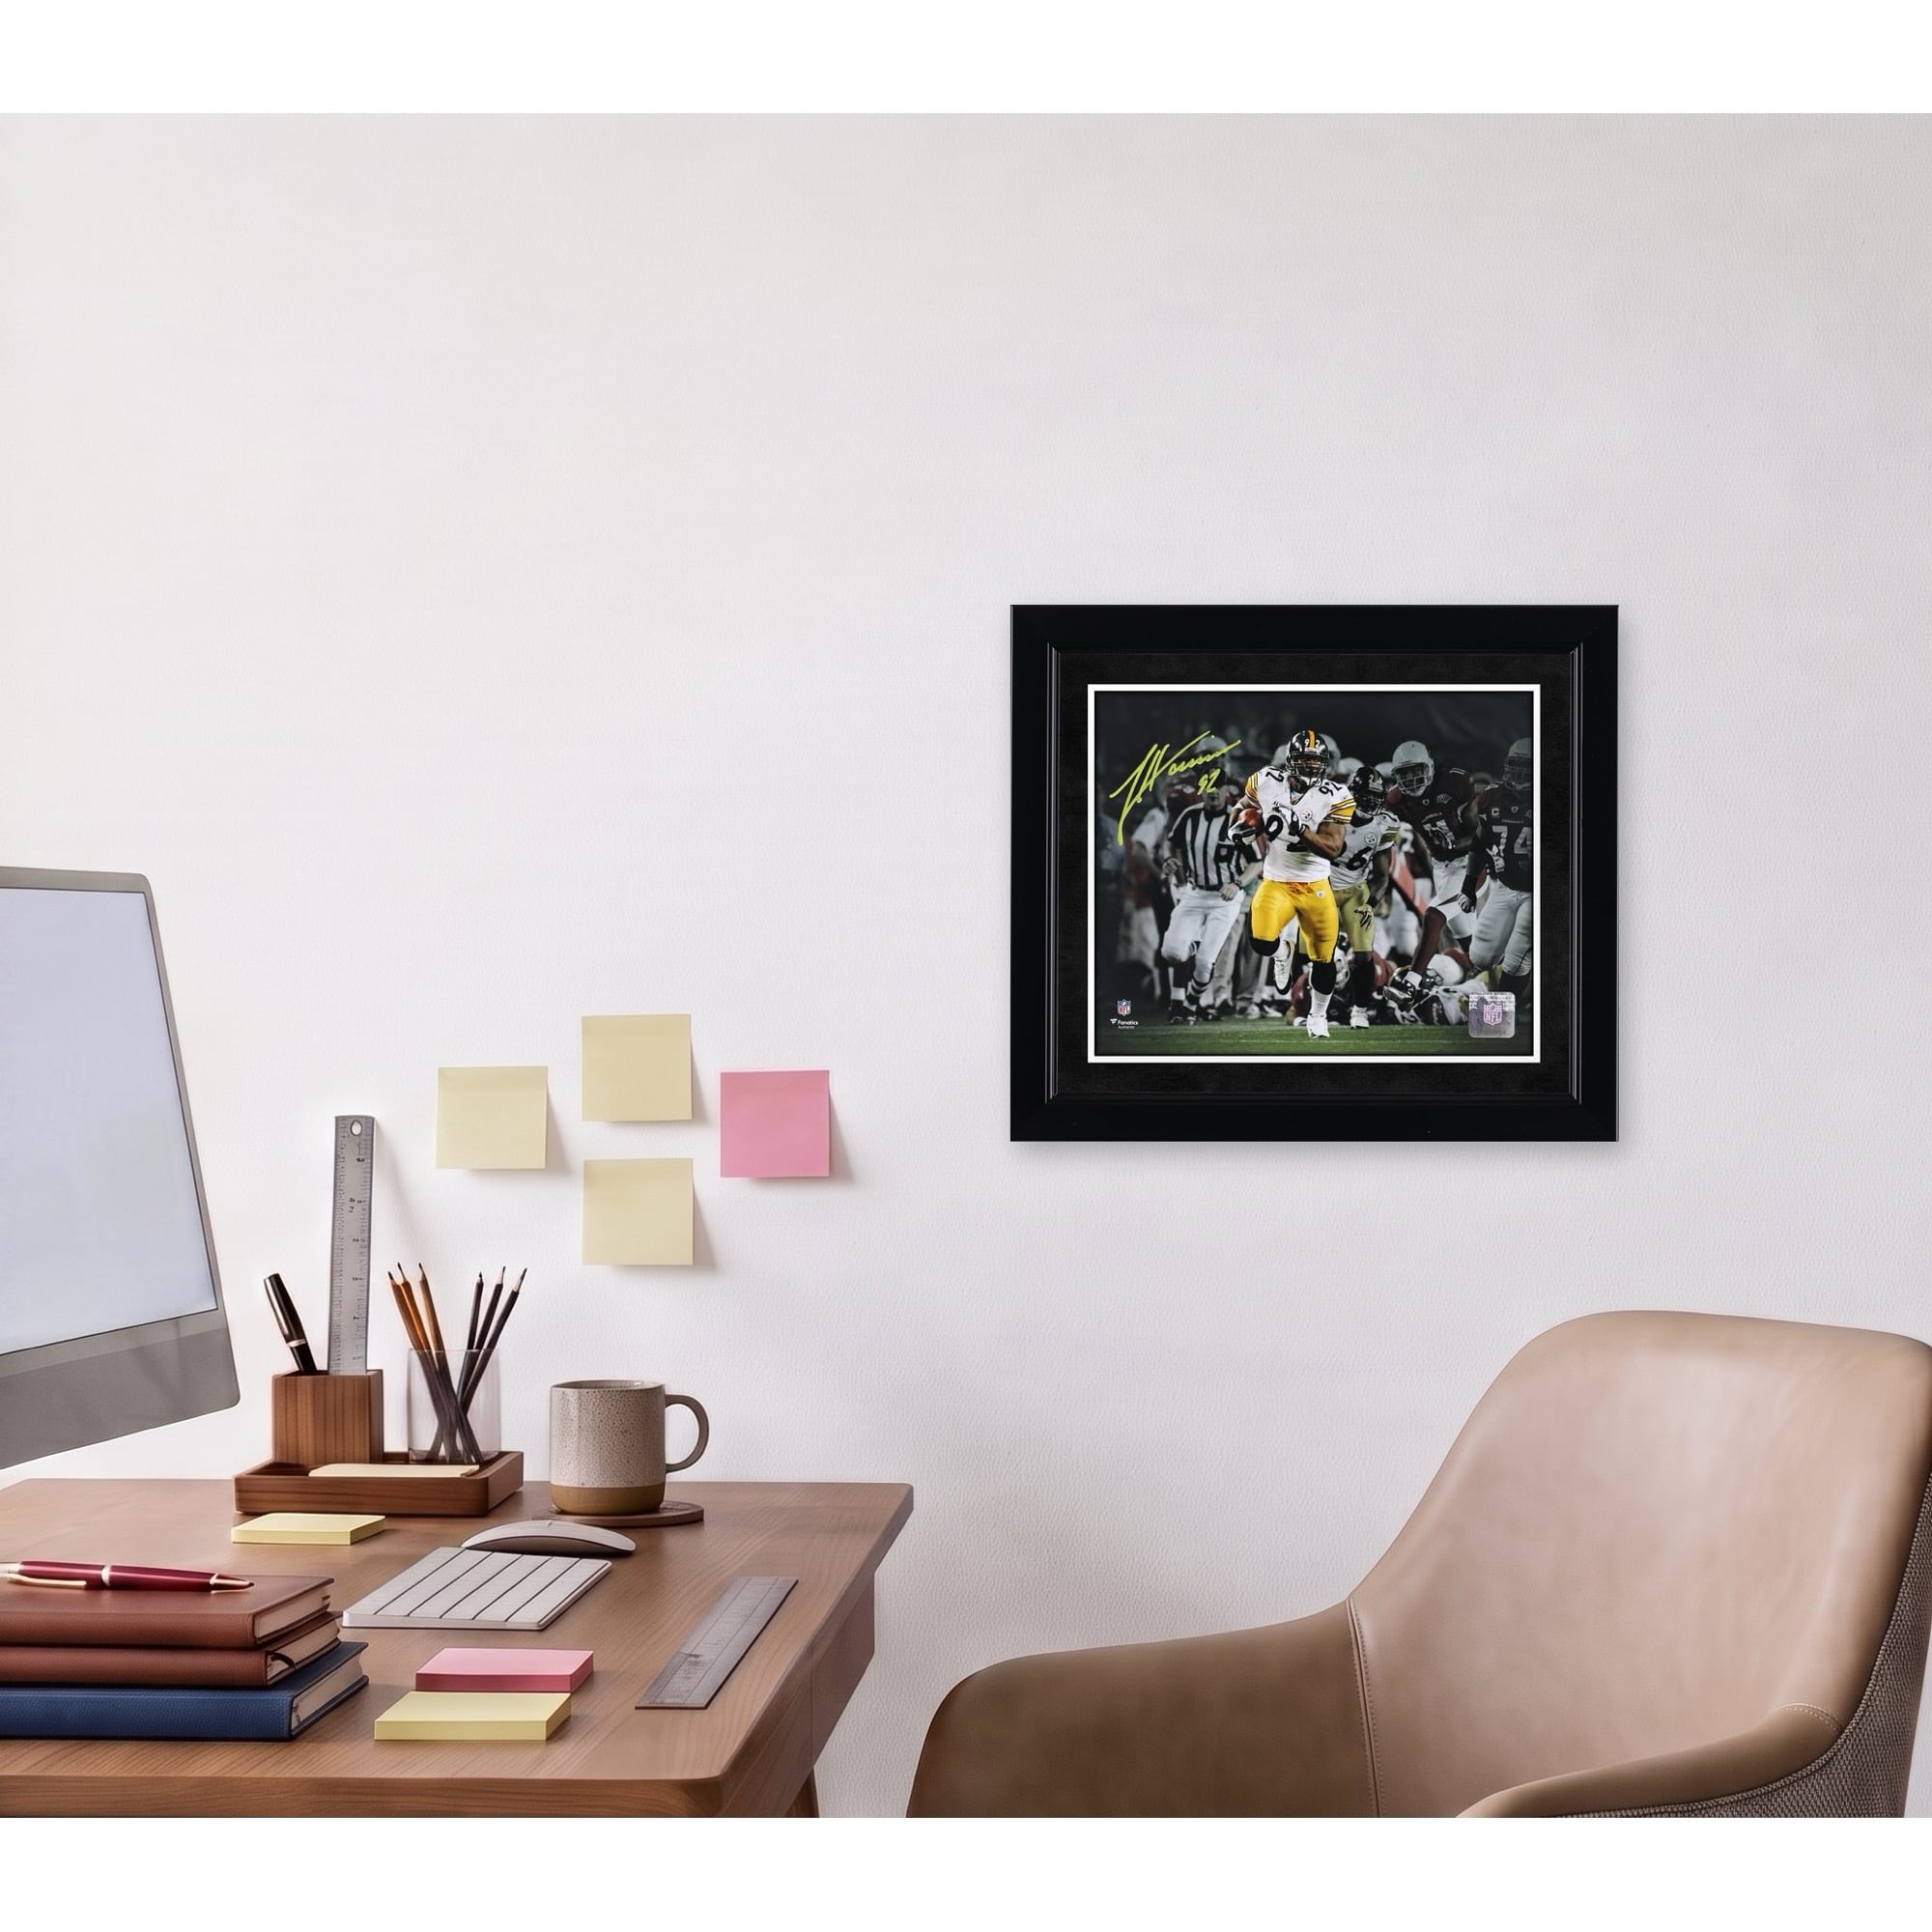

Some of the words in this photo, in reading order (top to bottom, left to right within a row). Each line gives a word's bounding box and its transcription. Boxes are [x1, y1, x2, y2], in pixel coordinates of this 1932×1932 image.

[1197, 768, 1221, 795] 92
[1492, 825, 1532, 856] 74
[1485, 1011, 1501, 1023] NFL
